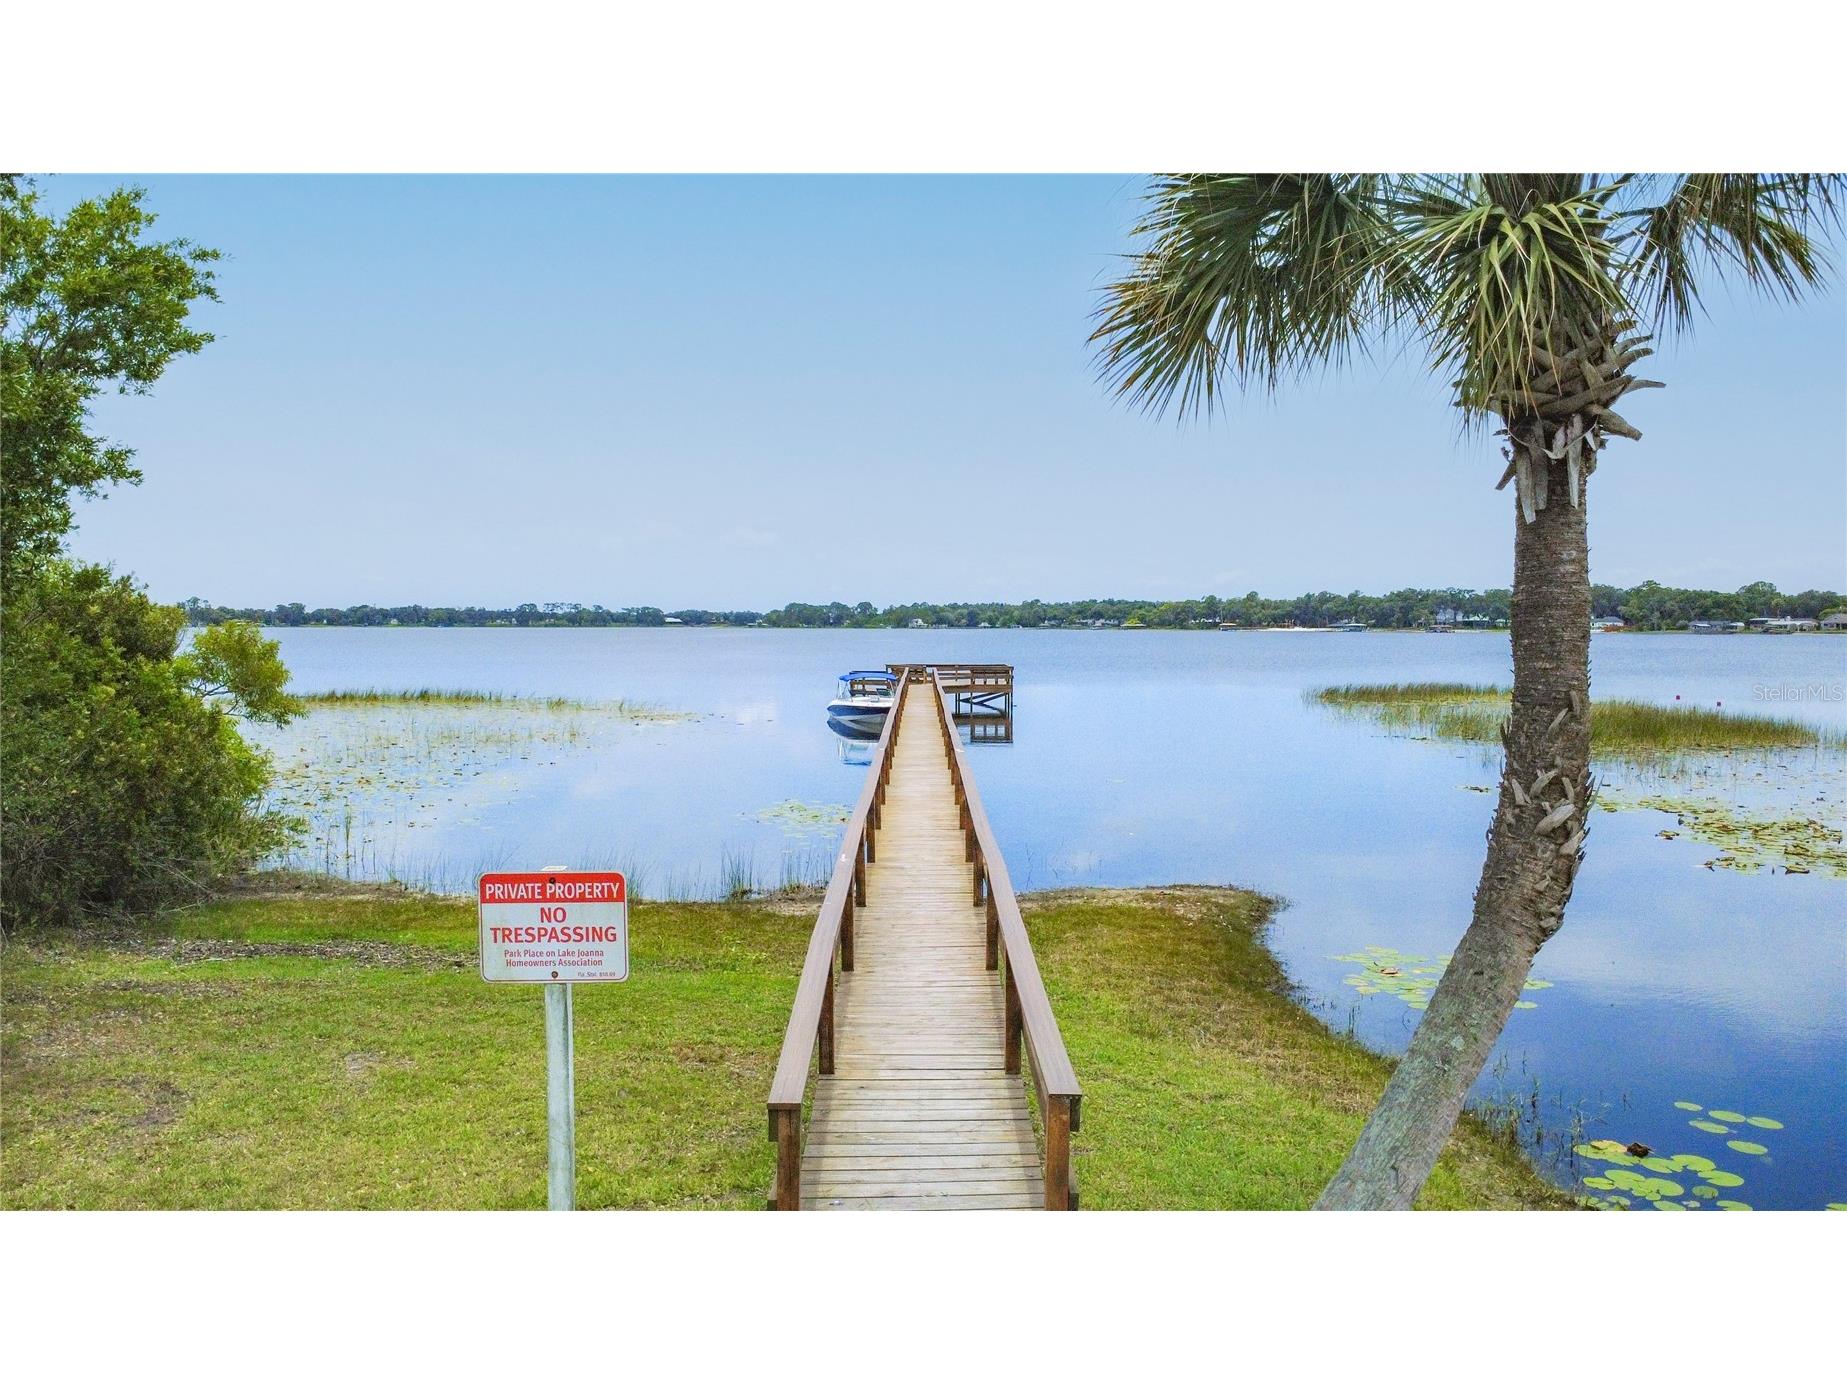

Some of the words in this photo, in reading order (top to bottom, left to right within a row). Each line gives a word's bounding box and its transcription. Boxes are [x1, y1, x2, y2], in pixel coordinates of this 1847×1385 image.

[485, 883, 542, 899] PRIVATE
[546, 882, 620, 899] PROPERTY
[540, 907, 567, 923] NO
[490, 926, 617, 943] TRESPASSING
[504, 949, 522, 958] Park
[523, 949, 544, 958] Place
[557, 949, 576, 957] Lake
[577, 949, 604, 958] Joanna
[506, 959, 556, 967] Homeowners
[558, 958, 603, 967] Association
